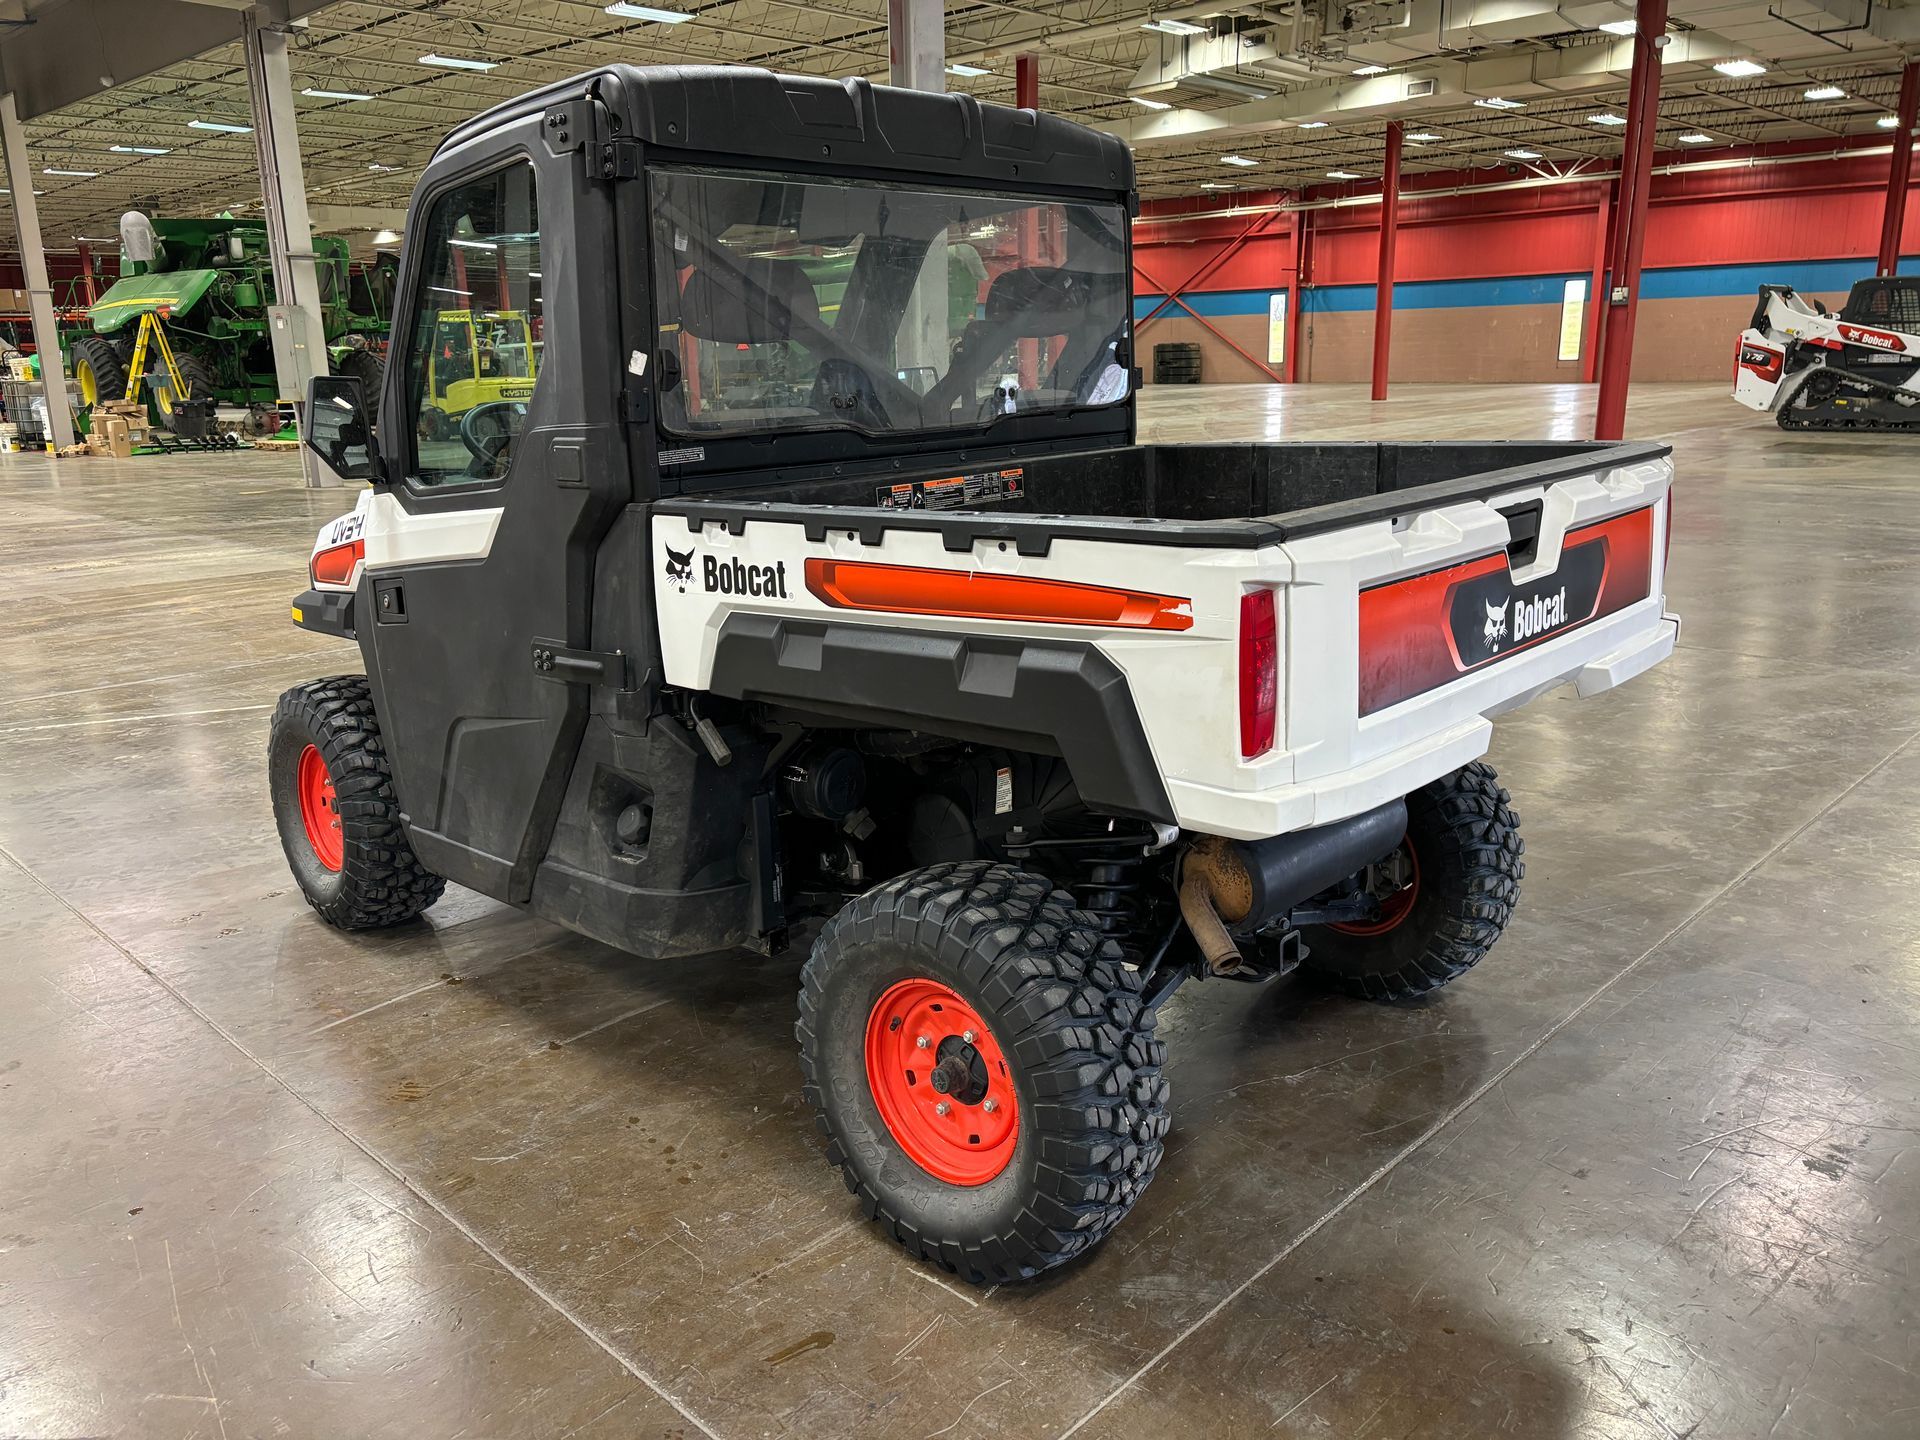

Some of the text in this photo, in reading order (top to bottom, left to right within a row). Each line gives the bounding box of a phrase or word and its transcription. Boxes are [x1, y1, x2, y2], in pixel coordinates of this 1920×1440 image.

[1862, 333, 1893, 348] Bobcat
[331, 514, 365, 544] UV34
[703, 555, 787, 598] Bobcat
[1514, 586, 1565, 642] Bobcat
